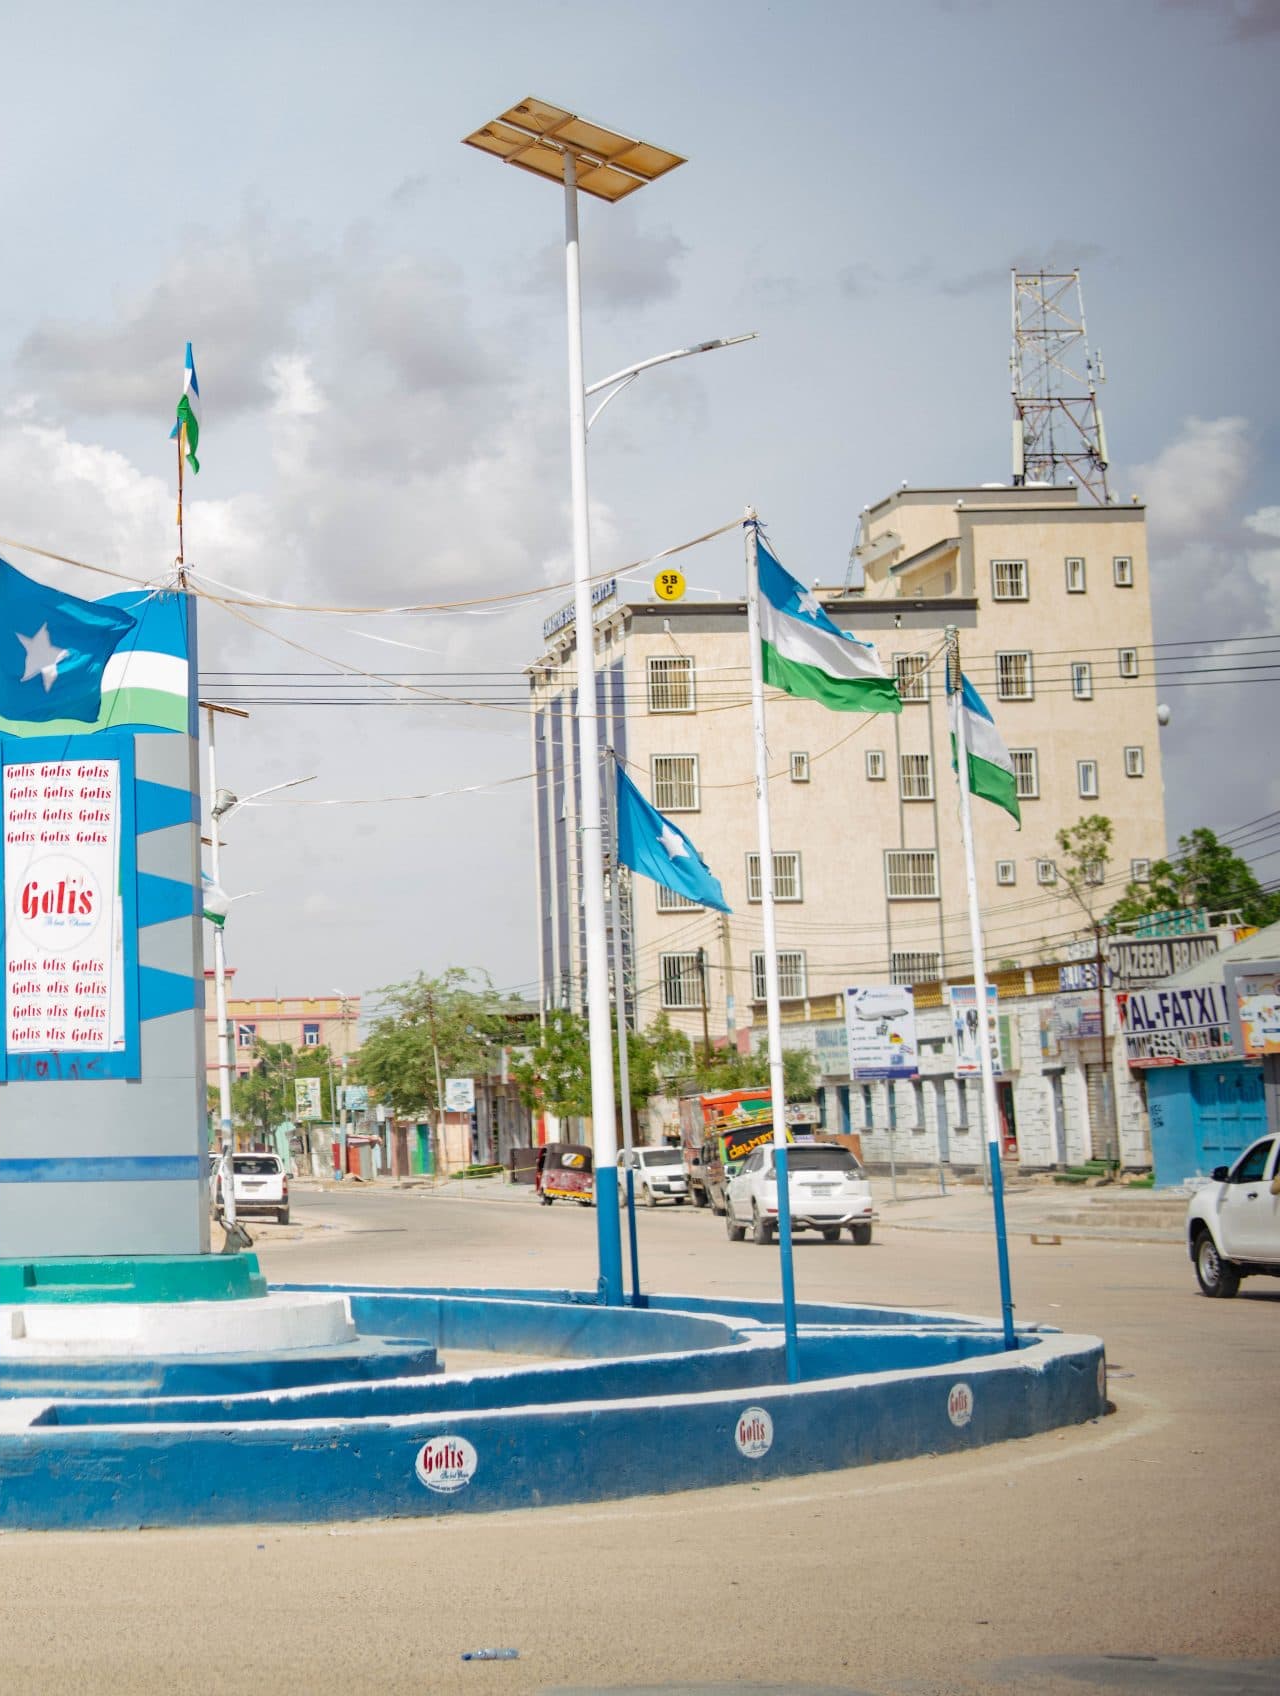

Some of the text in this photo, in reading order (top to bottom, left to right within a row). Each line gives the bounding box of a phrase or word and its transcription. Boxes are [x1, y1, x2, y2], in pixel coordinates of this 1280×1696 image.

[7, 765, 110, 779] Golis Golis Golis
[9, 786, 112, 800] Golis Golis Golis
[9, 808, 111, 822] Golis Golis Golis
[7, 831, 108, 844] Golis Golis Golis
[22, 879, 93, 920] Golis
[9, 959, 37, 973] Golis
[72, 959, 104, 973] Golis
[1119, 943, 1171, 977] JAZEERA
[12, 981, 41, 995] Golis
[75, 981, 107, 995] Golis
[13, 1005, 42, 1018] Golis
[74, 1005, 106, 1019] Golis
[1129, 984, 1218, 1031] AL-FATXI
[11, 1028, 41, 1041] Golis
[71, 1028, 103, 1041] Golis
[740, 1419, 766, 1446] Golis
[423, 1445, 464, 1474] Golis
